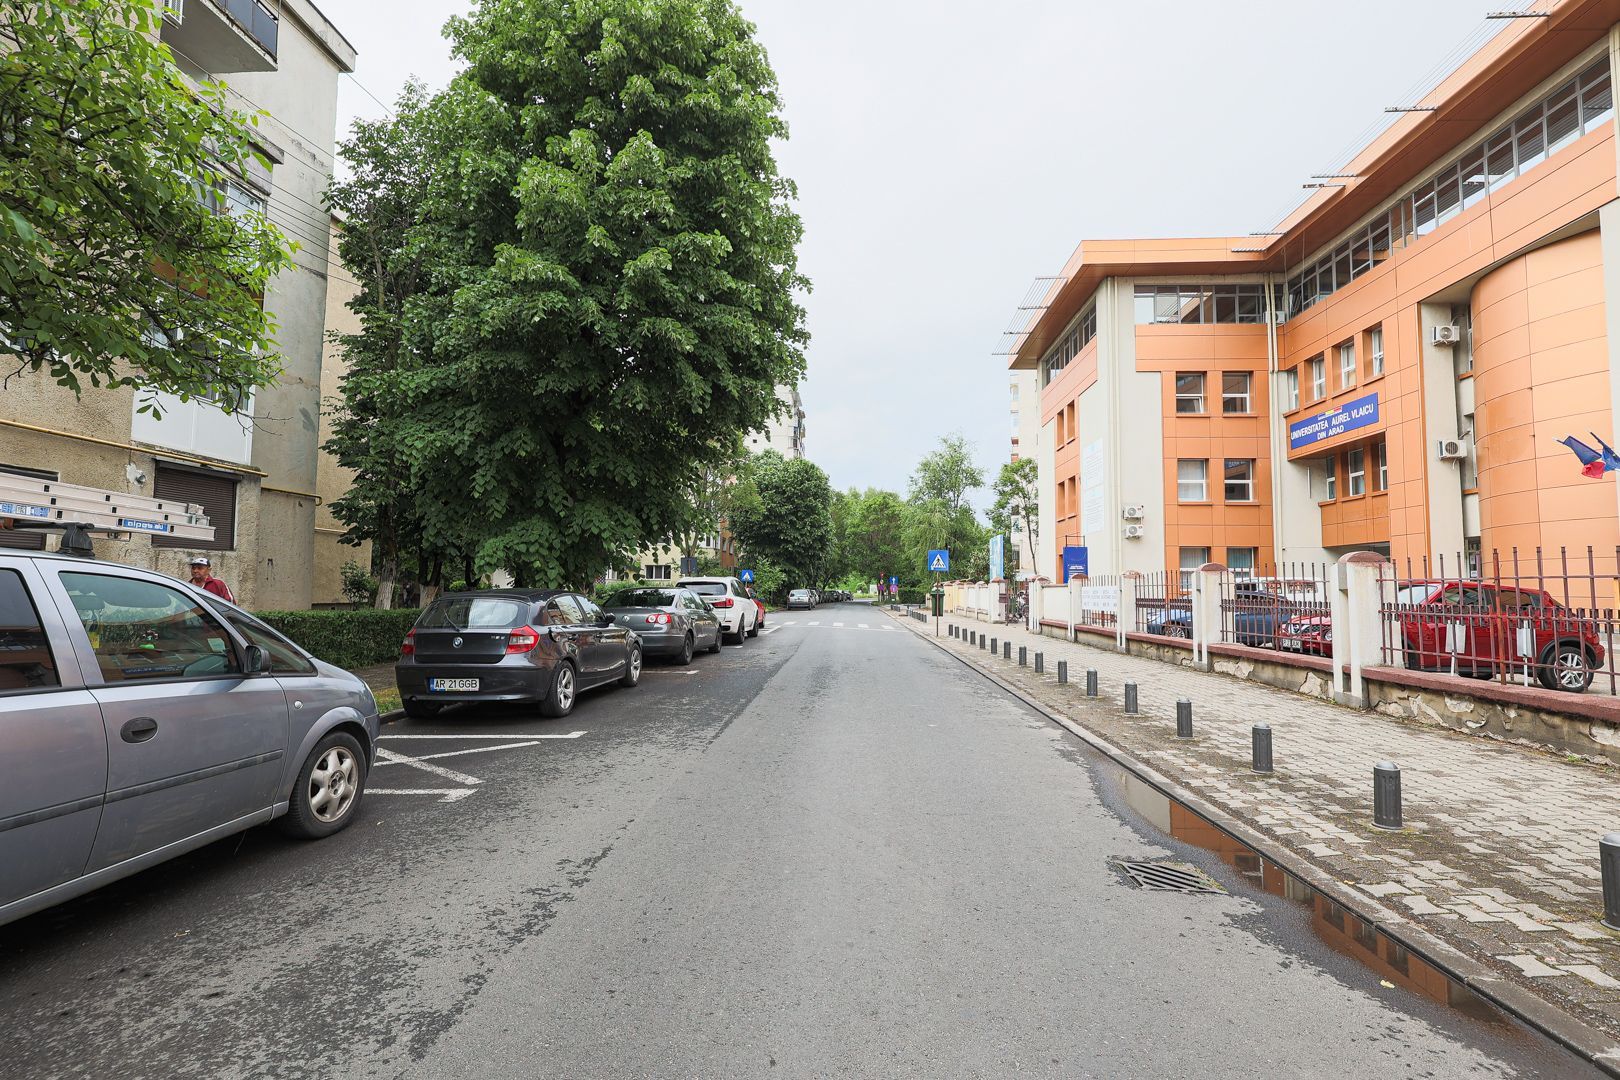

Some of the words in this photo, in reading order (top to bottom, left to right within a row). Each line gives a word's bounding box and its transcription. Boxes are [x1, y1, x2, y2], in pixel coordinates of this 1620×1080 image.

[1291, 421, 1328, 440] UNIVERSITATEA
[1331, 414, 1350, 426] AUREL
[1351, 404, 1373, 419] VLAICU
[1317, 432, 1327, 440] DIN
[1329, 425, 1345, 436] ARAD
[435, 679, 446, 688] AR
[448, 679, 457, 688] 21
[458, 679, 478, 688] GGB
